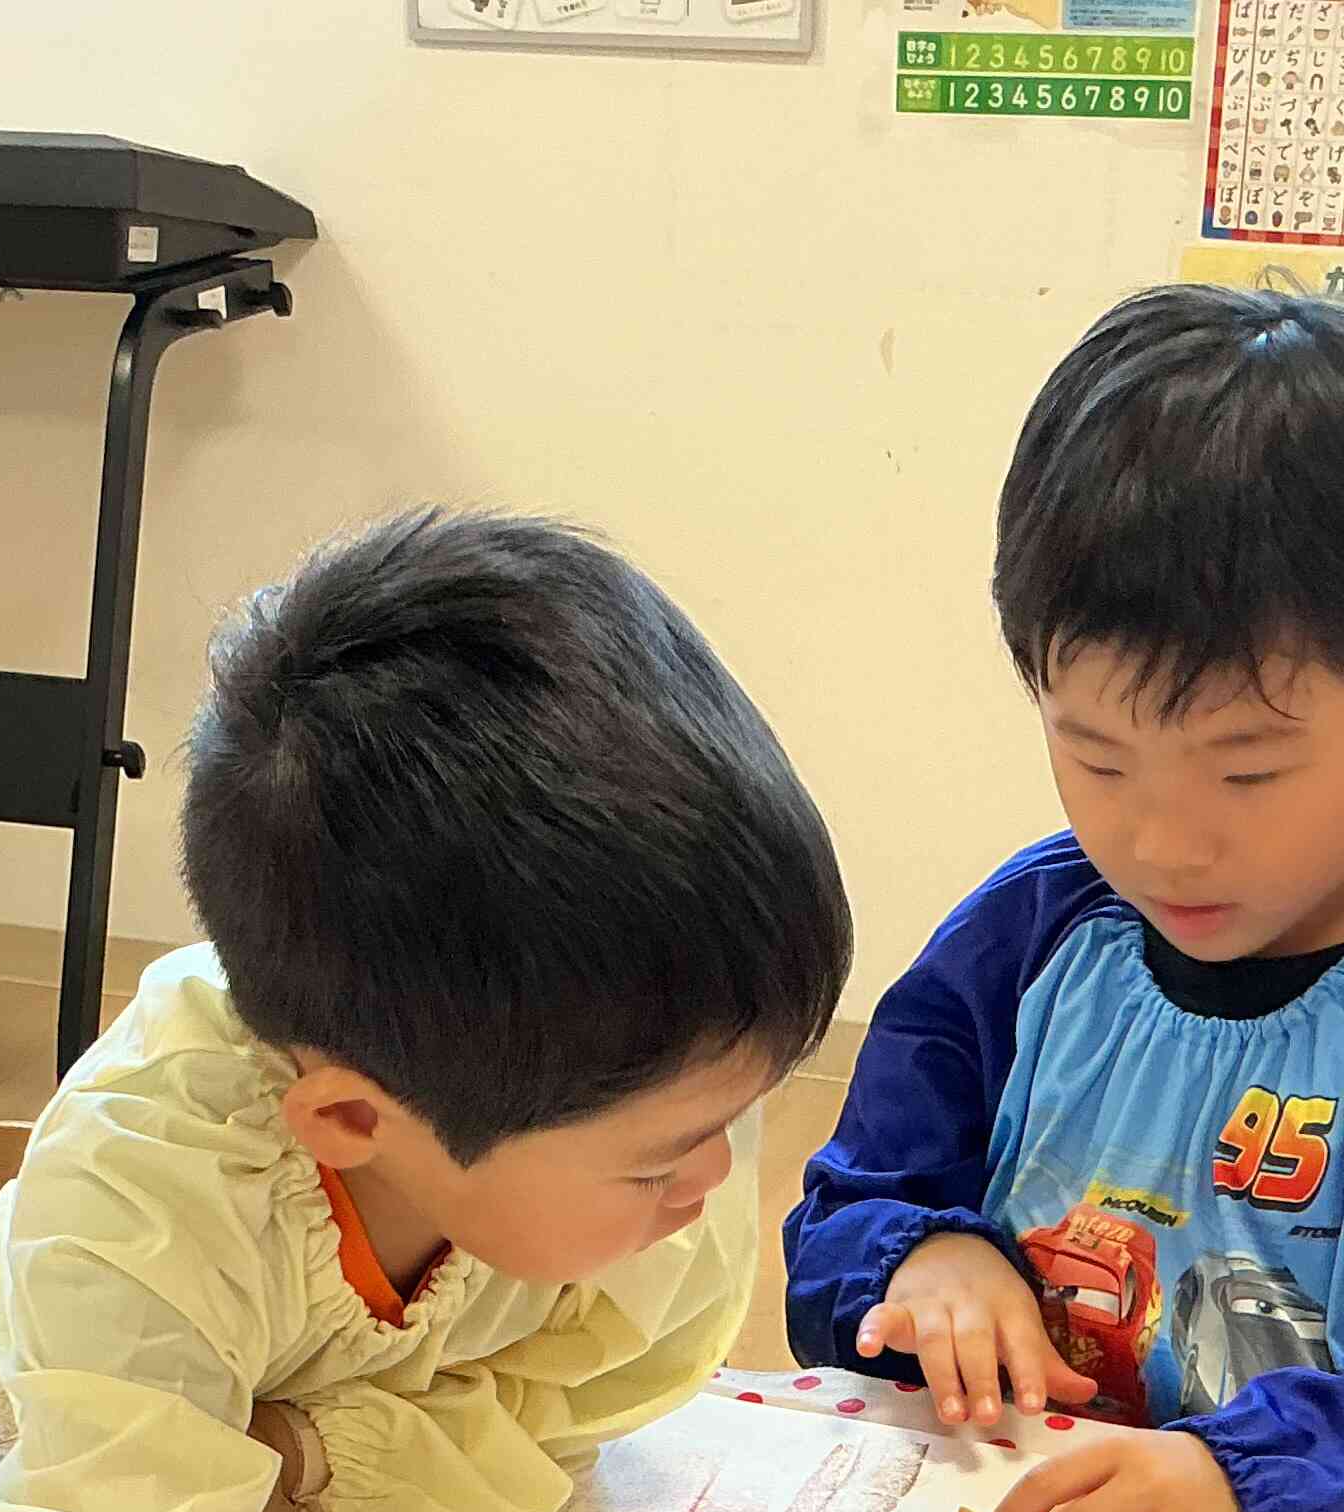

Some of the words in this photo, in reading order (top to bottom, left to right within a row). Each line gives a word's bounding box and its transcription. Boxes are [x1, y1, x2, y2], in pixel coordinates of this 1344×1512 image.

[950, 48, 956, 66] 1
[966, 44, 981, 68] 2
[990, 45, 1004, 68] 3
[1014, 46, 1029, 68] 4
[1039, 46, 1054, 70] 5
[1063, 47, 1078, 70] 6
[1087, 47, 1102, 70] 7
[1111, 48, 1127, 70] 8
[1136, 48, 1152, 70] 9
[1161, 49, 1185, 72] 10
[1314, 51, 1325, 67] じ
[949, 82, 955, 106] 1
[964, 84, 979, 108] 2
[988, 84, 1004, 106] 3
[1012, 84, 1028, 108] 4
[1036, 86, 1052, 108] 5
[1061, 86, 1076, 110] 6
[1085, 86, 1100, 110] 7
[1110, 87, 1125, 111] 8
[1134, 88, 1149, 111] 9
[1159, 88, 1183, 112] 10
[1303, 145, 1320, 160] ぜ
[1329, 146, 1344, 162] げ
[1213, 1085, 1339, 1212] 95
